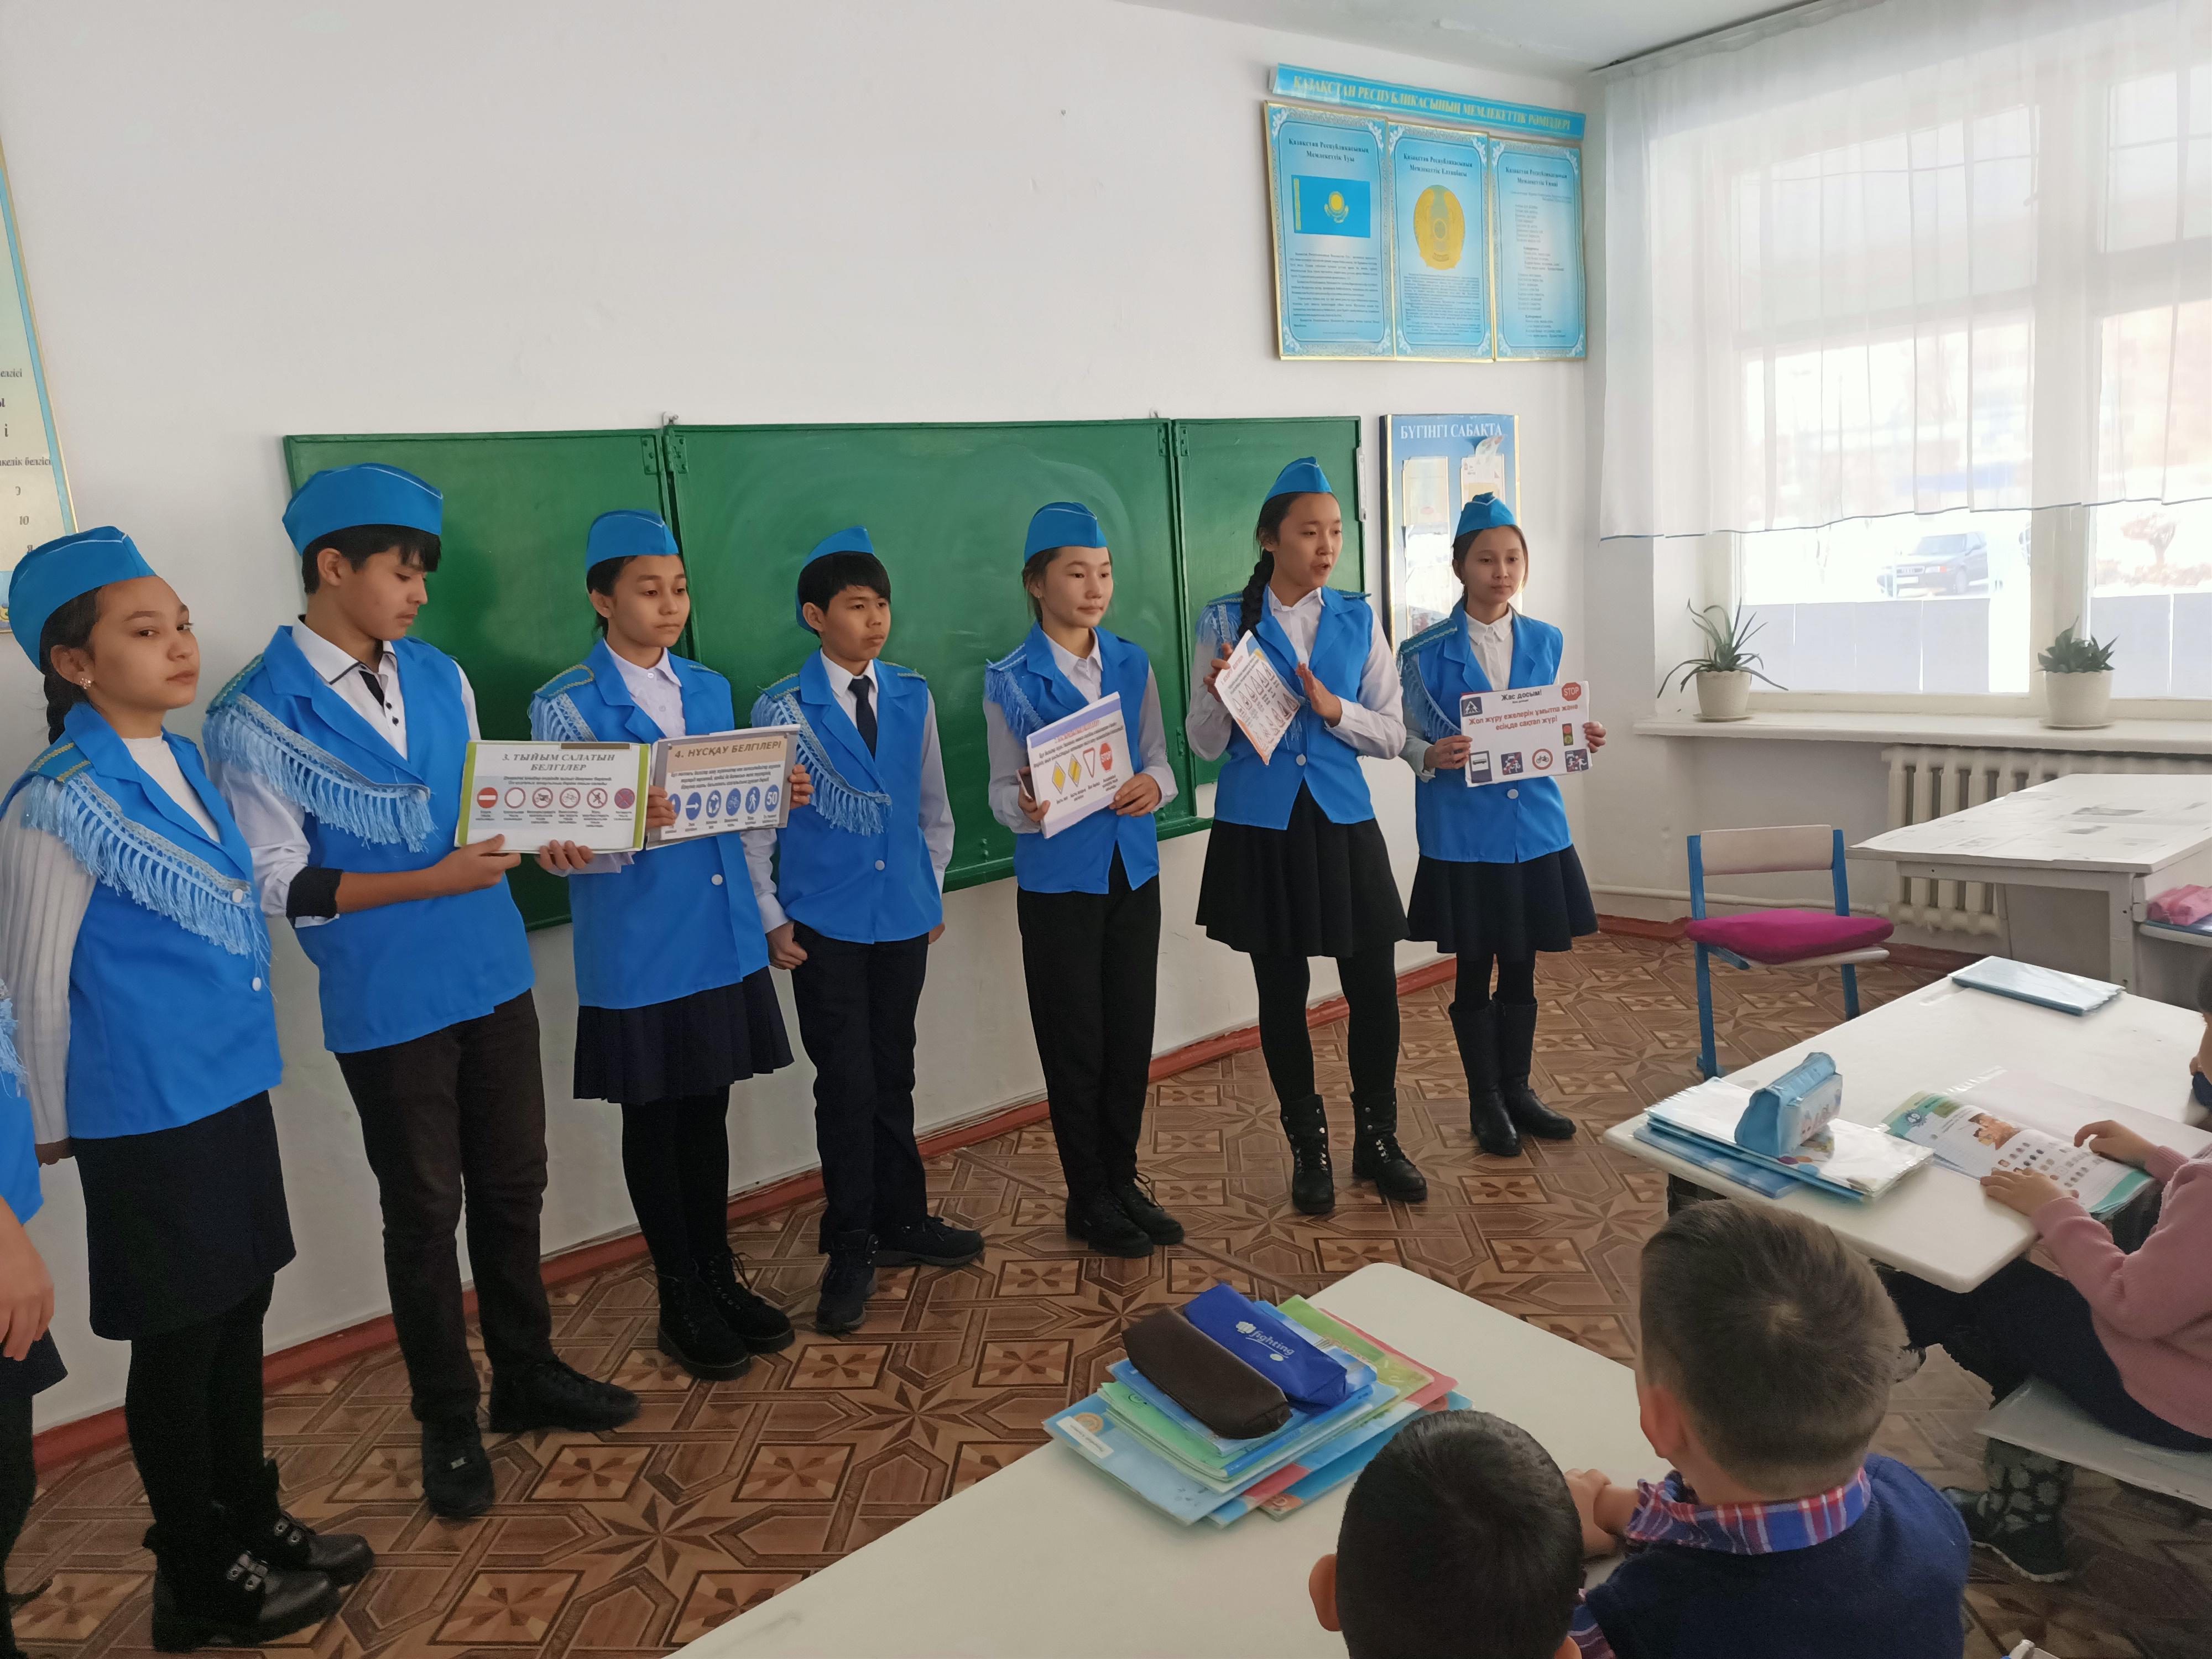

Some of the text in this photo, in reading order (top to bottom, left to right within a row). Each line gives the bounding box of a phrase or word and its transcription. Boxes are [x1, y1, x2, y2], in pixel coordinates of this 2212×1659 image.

[0, 368, 23, 378] елгісі
[1400, 424, 1448, 439] БҮГІНГІ
[1517, 689, 1542, 700] досым!
[1563, 686, 1579, 696] STOP
[732, 740, 782, 753] БЕЛГІЛЕРІ
[513, 753, 559, 761] ТЫЙЫМ
[561, 753, 615, 761] САЛАТЫН
[766, 791, 778, 806] 50
[1250, 1330, 1295, 1356] fighting
